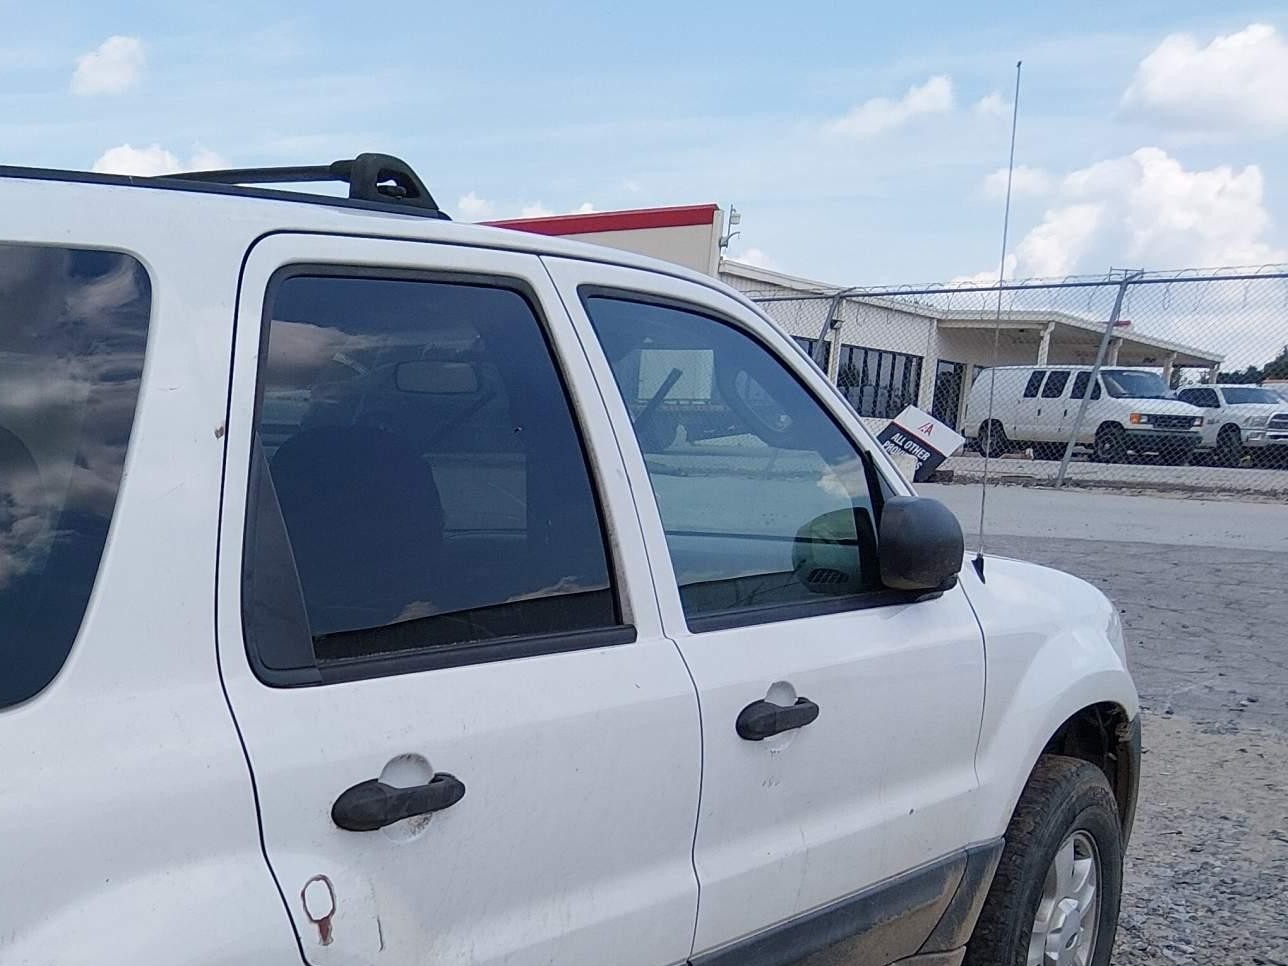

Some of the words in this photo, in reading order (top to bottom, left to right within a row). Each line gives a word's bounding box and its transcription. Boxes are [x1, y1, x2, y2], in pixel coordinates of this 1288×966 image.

[881, 440, 923, 471] PROVS
[891, 432, 904, 446] ALL
[903, 439, 931, 461] OTHER
